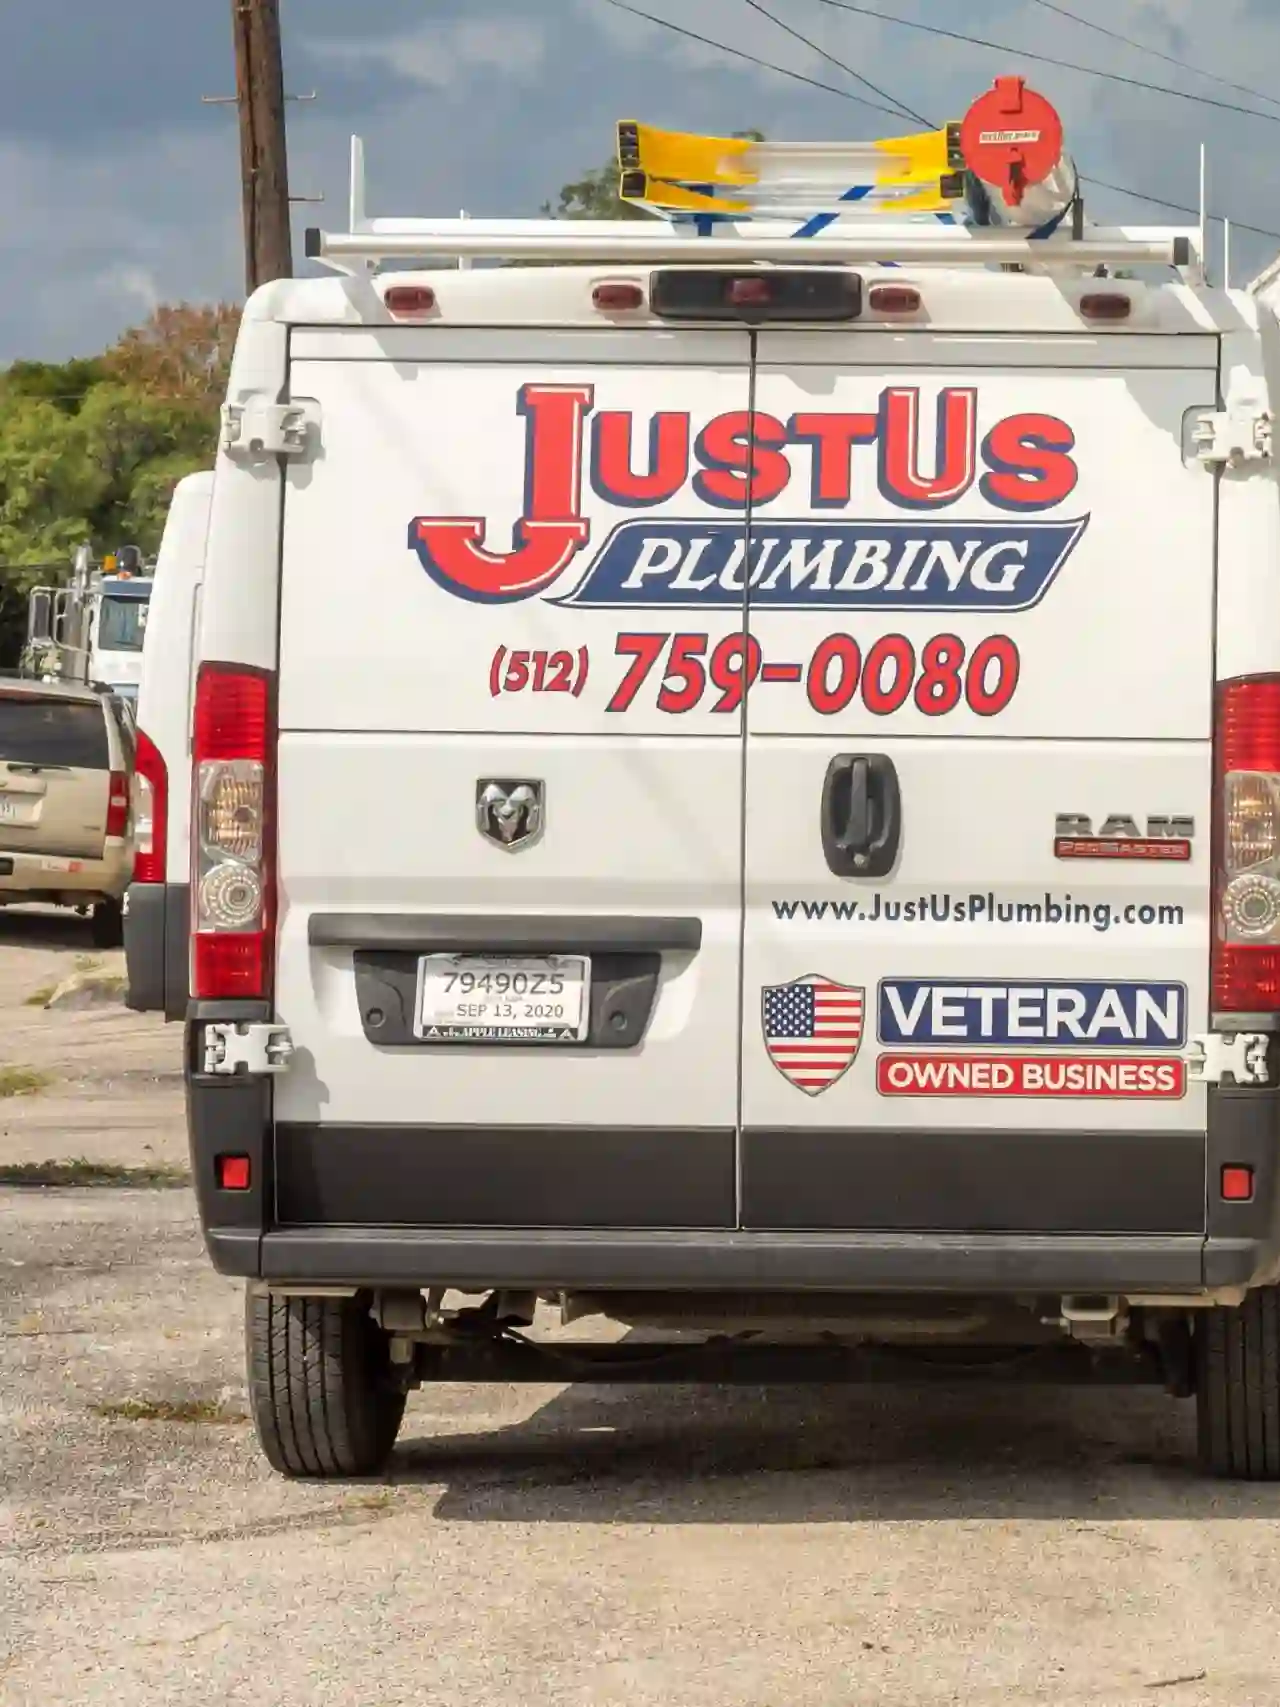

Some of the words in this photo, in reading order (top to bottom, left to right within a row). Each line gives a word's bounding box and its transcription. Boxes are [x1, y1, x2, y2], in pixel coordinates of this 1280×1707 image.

[619, 537, 1030, 592] PLUMBING
[489, 644, 589, 698] (512)
[604, 632, 1020, 717] 759-0080
[1055, 813, 1194, 837] RAM
[772, 893, 1184, 931] www.JustUsPlumbing.com
[443, 972, 564, 995] 79490Z5
[456, 1003, 488, 1018] SEP
[524, 1004, 564, 1019] 2020
[883, 986, 1179, 1040] VETERAN
[887, 1061, 1014, 1089] OWNED
[1023, 1063, 1175, 1091] BUSINESS
